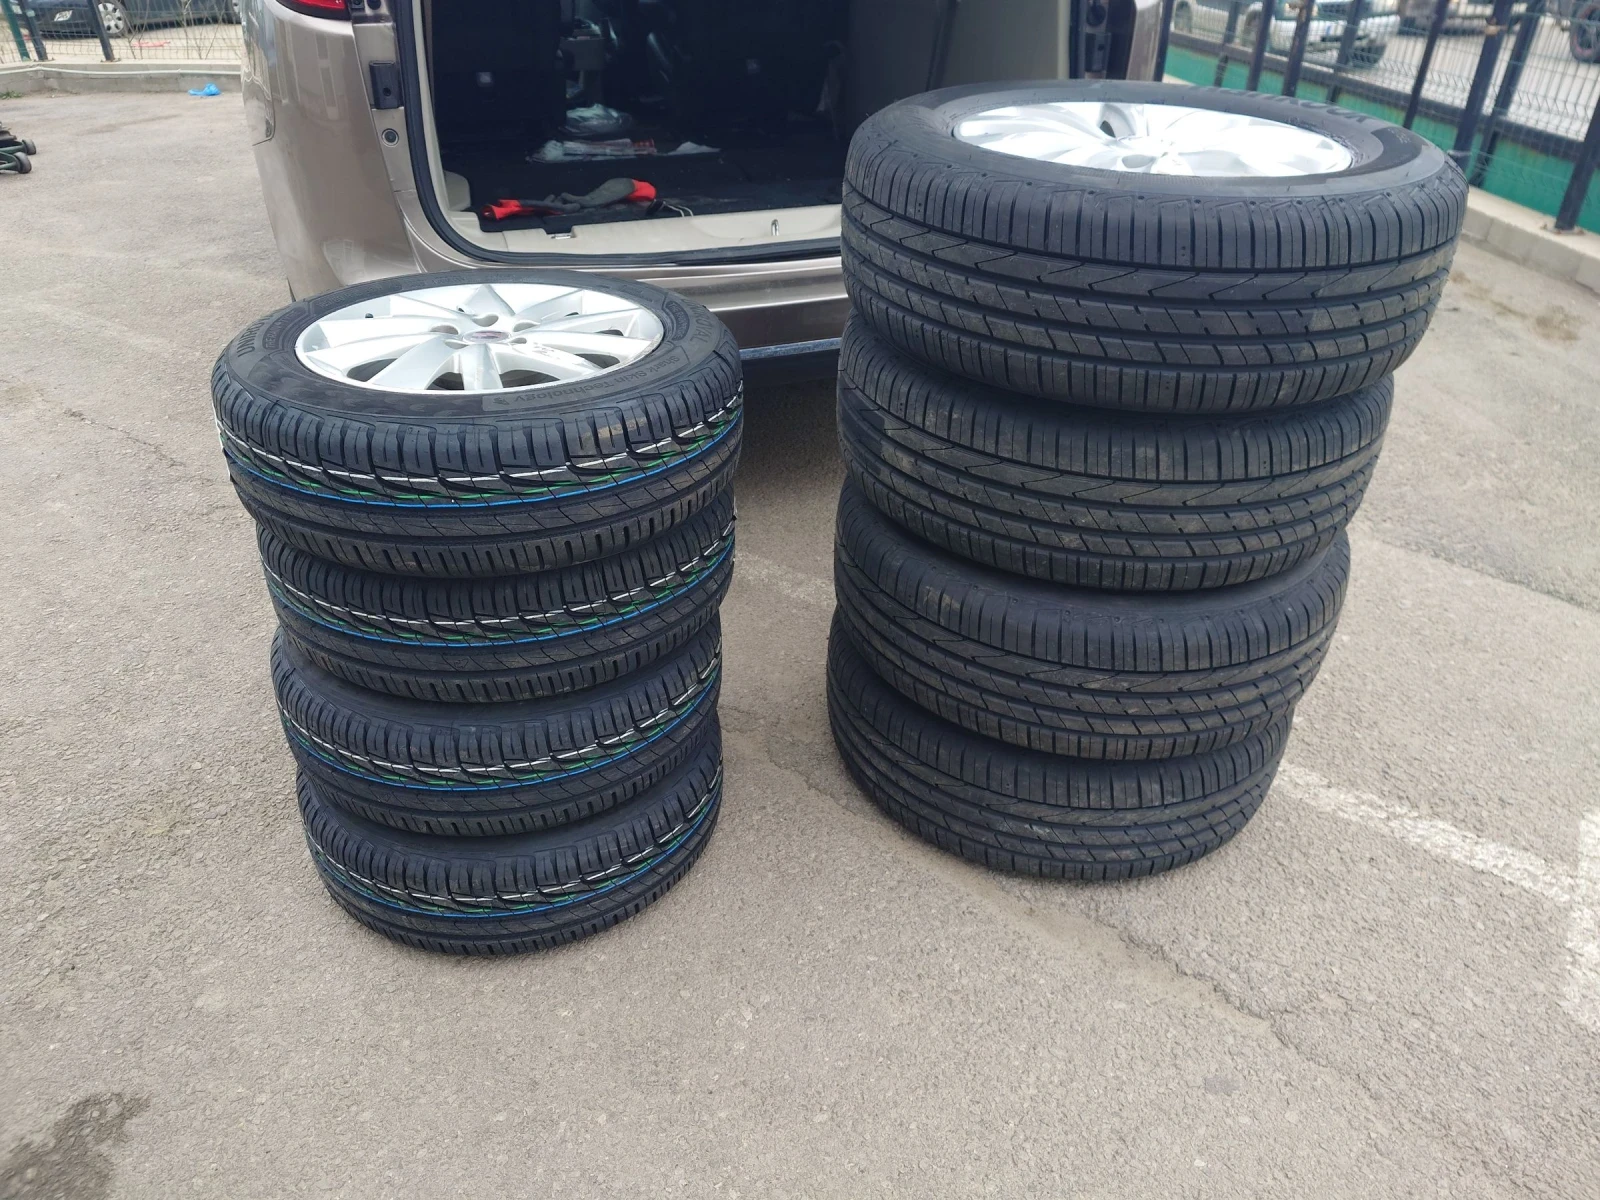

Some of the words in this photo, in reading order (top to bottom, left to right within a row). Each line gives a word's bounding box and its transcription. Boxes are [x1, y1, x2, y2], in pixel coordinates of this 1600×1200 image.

[649, 355, 680, 372] Shark
[615, 370, 647, 384] Skin
[515, 382, 615, 401] Technology
